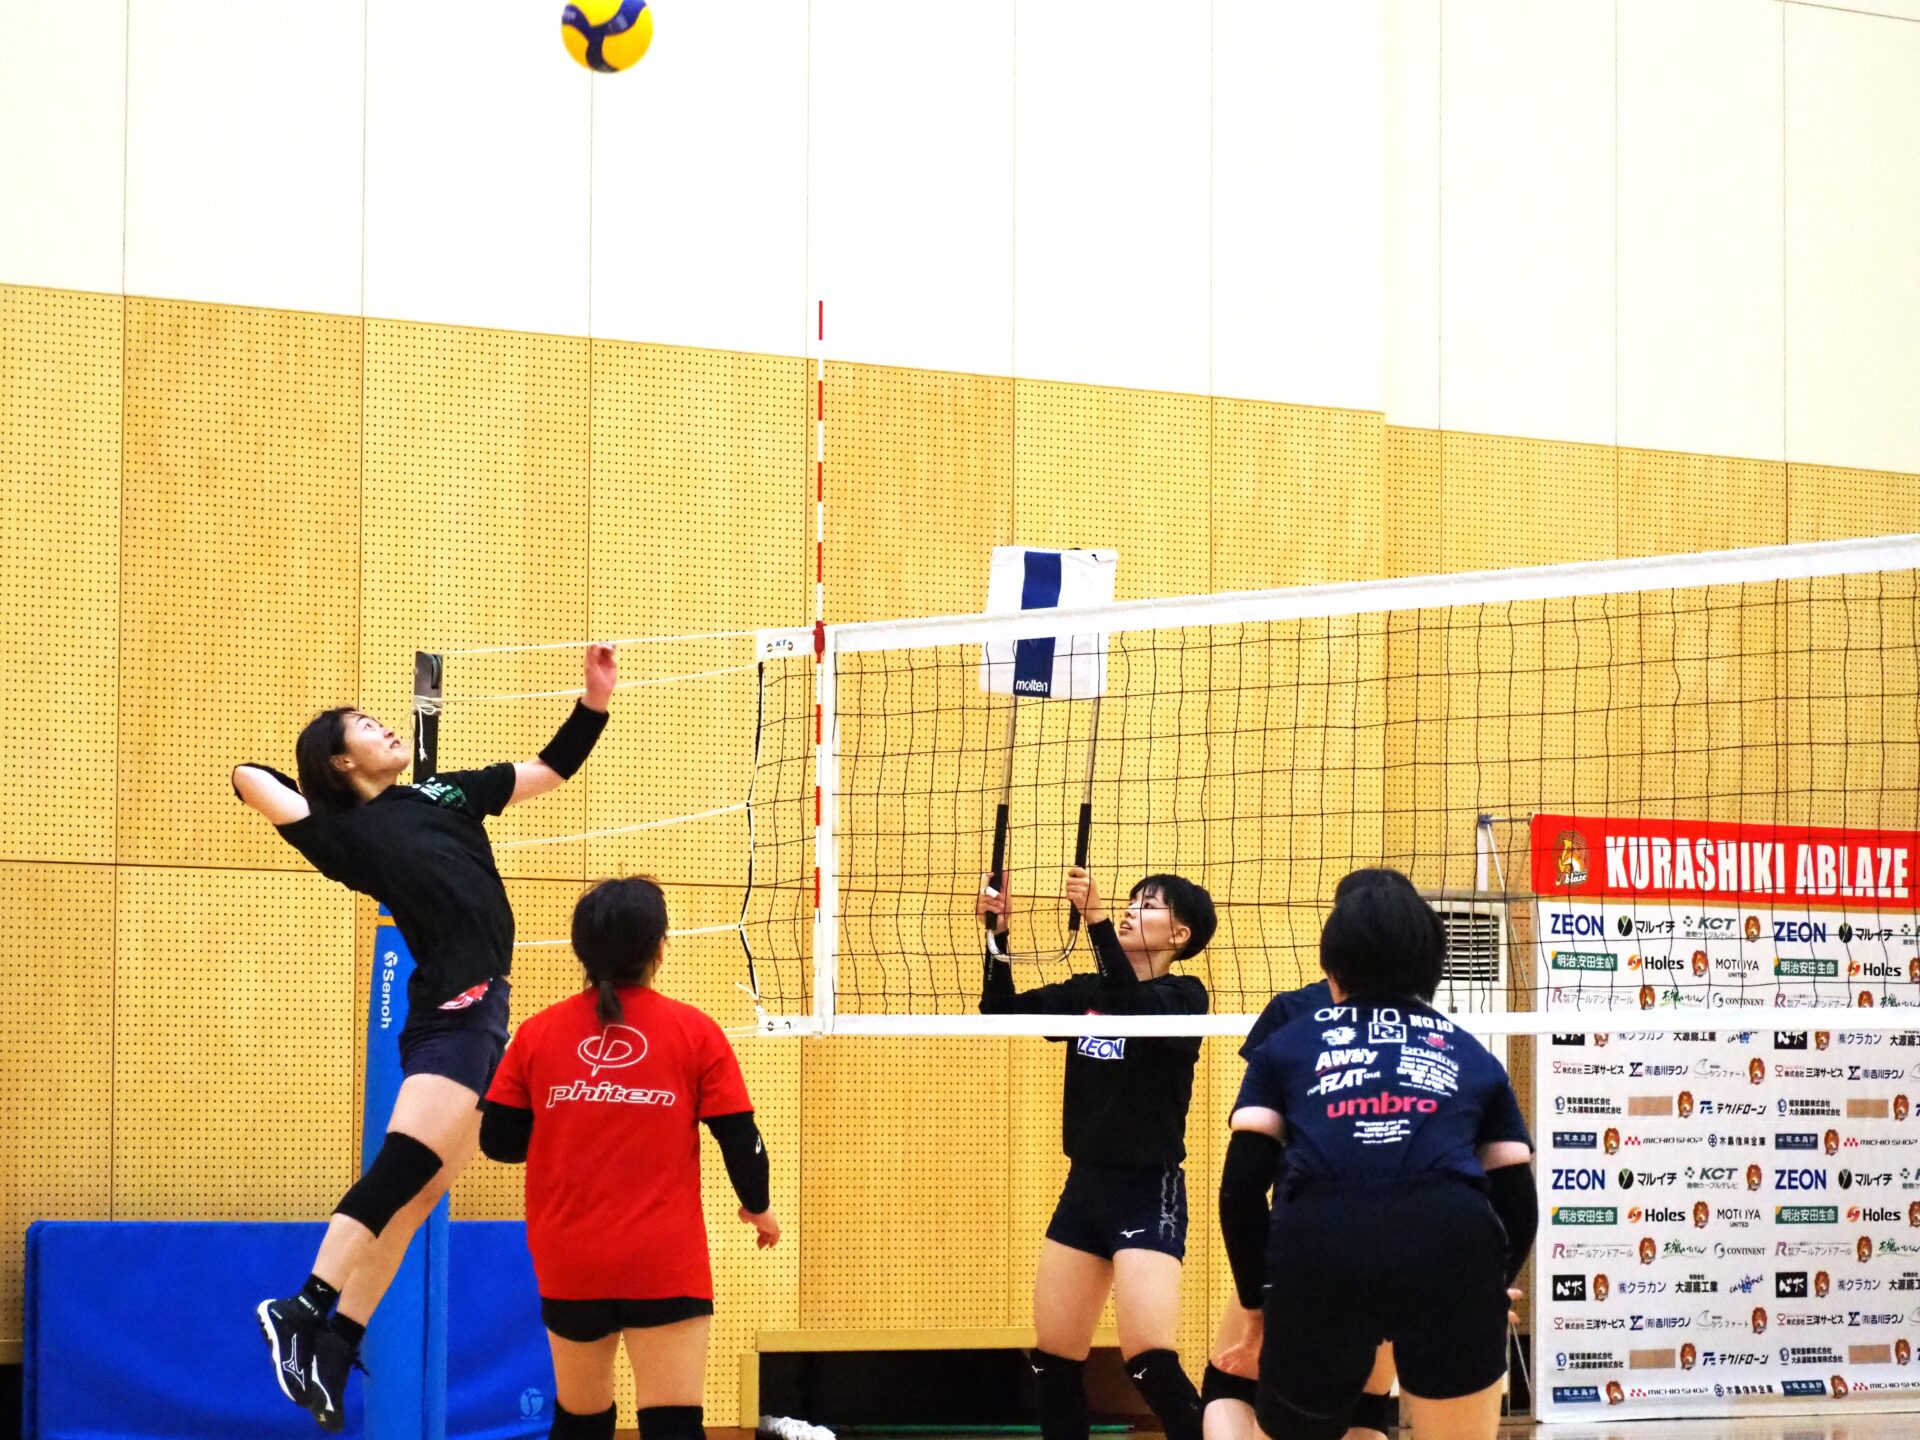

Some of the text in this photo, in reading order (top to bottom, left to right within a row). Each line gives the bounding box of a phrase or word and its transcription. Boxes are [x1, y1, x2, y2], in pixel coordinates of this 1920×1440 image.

[1015, 680, 1048, 692] molten
[1605, 836, 1908, 898] KURASHIKI ABLAZE
[1551, 914, 1604, 936] ZEON
[1636, 920, 1676, 933] マルイチ
[1698, 917, 1736, 930] KCT
[1774, 922, 1826, 943] ZEON
[1856, 928, 1893, 941] マルイチ
[1557, 954, 1615, 968] 明治安田生命
[1645, 956, 1685, 970] Holes
[1781, 961, 1835, 975] 明治安田生命
[1864, 963, 1902, 977] Holes
[381, 969, 395, 1028] Senoh
[1725, 998, 1764, 1006] CONTINENT
[1078, 1036, 1123, 1058] ZEON
[1584, 1064, 1625, 1076] 三洋サービス
[1806, 1067, 1844, 1079] 三洋サービス
[546, 1081, 676, 1108] phiten
[1327, 1091, 1438, 1118] umbro
[1552, 1169, 1605, 1190] ZEON
[1637, 1173, 1677, 1186] マルイチ
[1700, 1168, 1738, 1180] KCT
[1775, 1170, 1827, 1190] ZEON
[1855, 1173, 1893, 1187] マルイチ
[1559, 1210, 1614, 1223] 明治安田生命
[1645, 1208, 1686, 1222] Holes
[1782, 1209, 1836, 1222] 明治安田生命
[1863, 1208, 1901, 1222] Holes
[1726, 1247, 1766, 1256] CONTINENT
[1586, 1318, 1626, 1330] 三洋サービス
[1806, 1314, 1844, 1326] 三洋サービス
